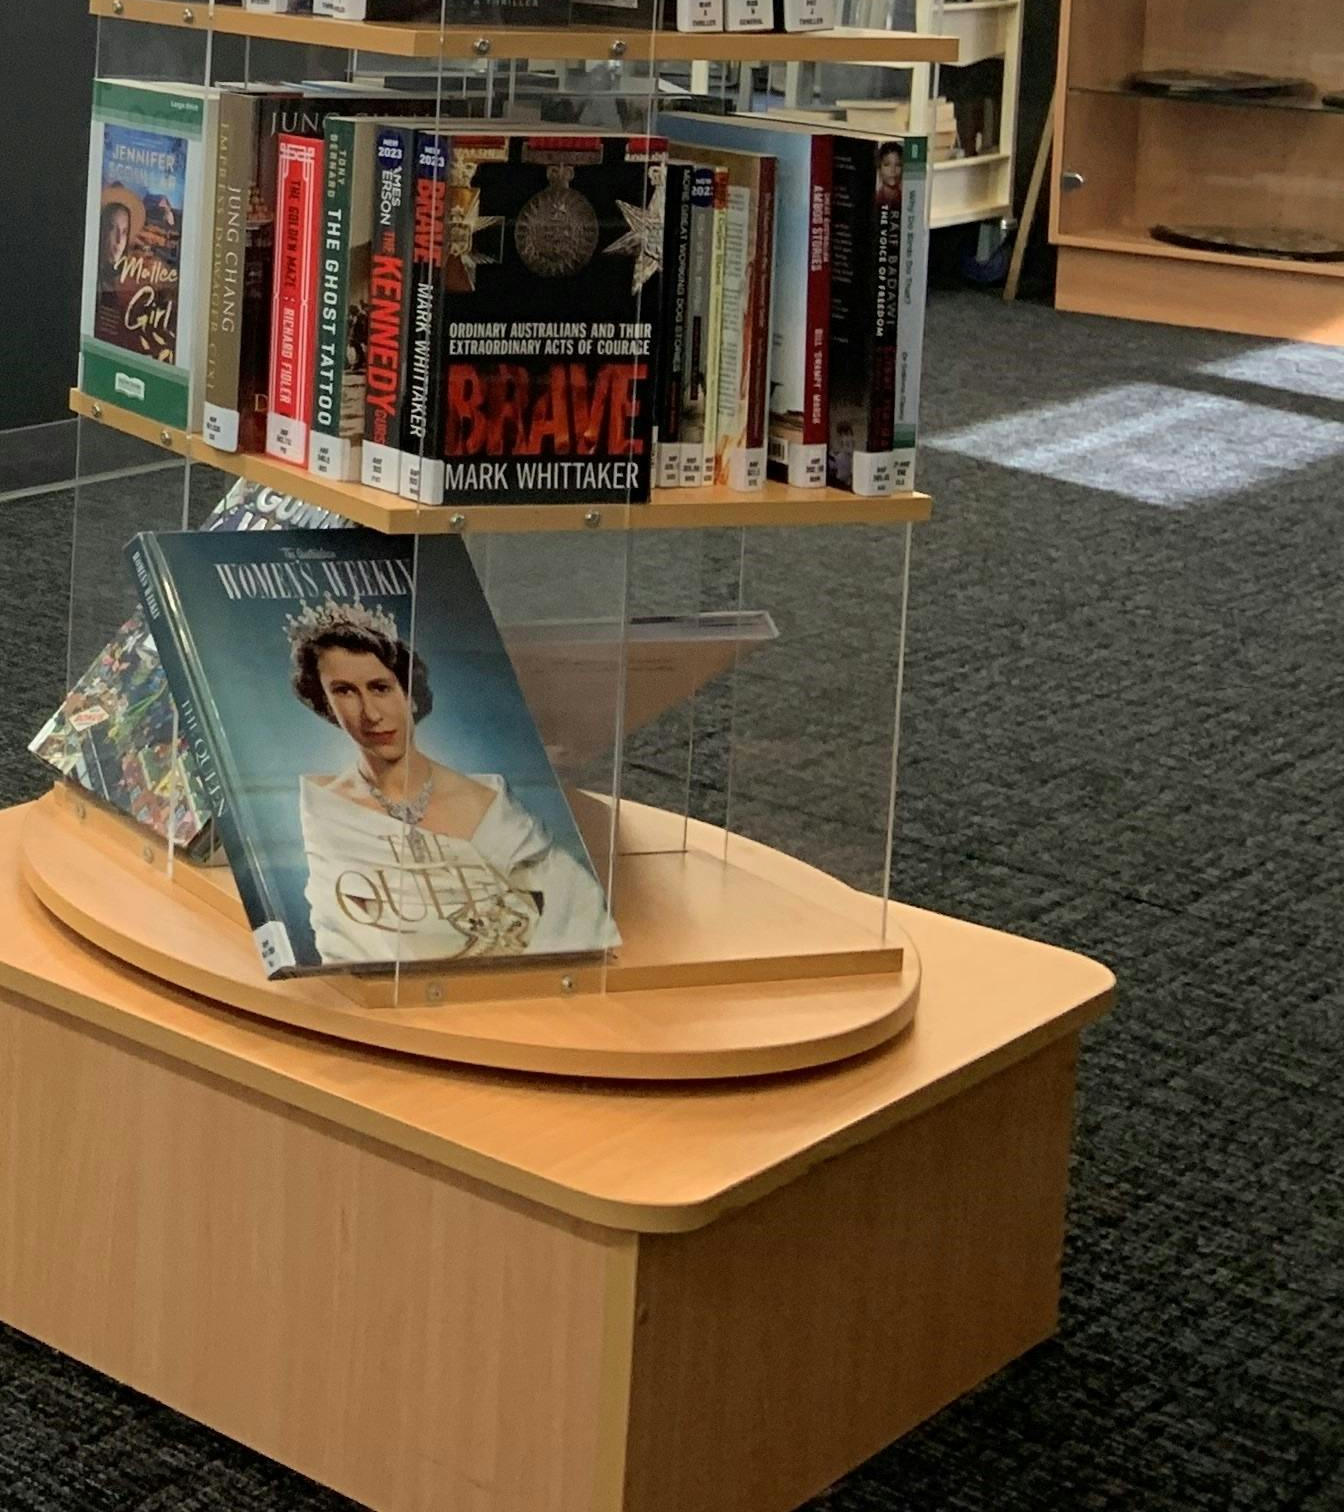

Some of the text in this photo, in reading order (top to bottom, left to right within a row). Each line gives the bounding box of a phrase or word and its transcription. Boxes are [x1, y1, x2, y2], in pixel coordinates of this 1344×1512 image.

[112, 143, 176, 172] JENNIFER
[327, 133, 338, 198] BERNARD
[338, 150, 348, 185] TONY
[378, 146, 403, 159] 2023
[382, 139, 399, 147] NEW
[419, 154, 445, 168] 2023
[379, 169, 394, 226] ERSON
[413, 177, 446, 268] BRAVE
[326, 209, 342, 251] THE
[114, 252, 178, 284] Mallee
[221, 185, 242, 333] JUNG CHANG
[676, 244, 687, 296] WORKING
[874, 204, 889, 337] THE VOICE OF FREEDOM
[885, 210, 900, 326] RAIF BADAWI
[124, 285, 171, 333] Girl
[279, 180, 301, 404] THE GOLDEN MAZE RICHARD FIDLER
[322, 259, 340, 336] GHOST
[365, 254, 405, 416] KENNEDY
[449, 322, 652, 339] ORDINARY AUSTRALIANS AND THEIR
[449, 339, 651, 356] EXTRAORDINARY ACTS OF COURAGE
[317, 343, 336, 427] TATTOO
[409, 283, 434, 440] MARK WHITTAKER
[444, 362, 649, 456] BRAVE
[444, 462, 510, 490] MARK
[516, 461, 640, 490] WHITTAKER
[215, 558, 416, 600] WOMEN'S WEEKLY
[181, 699, 226, 818] THE QUEEN
[378, 833, 458, 865] THE
[336, 864, 516, 934] QUEEN
